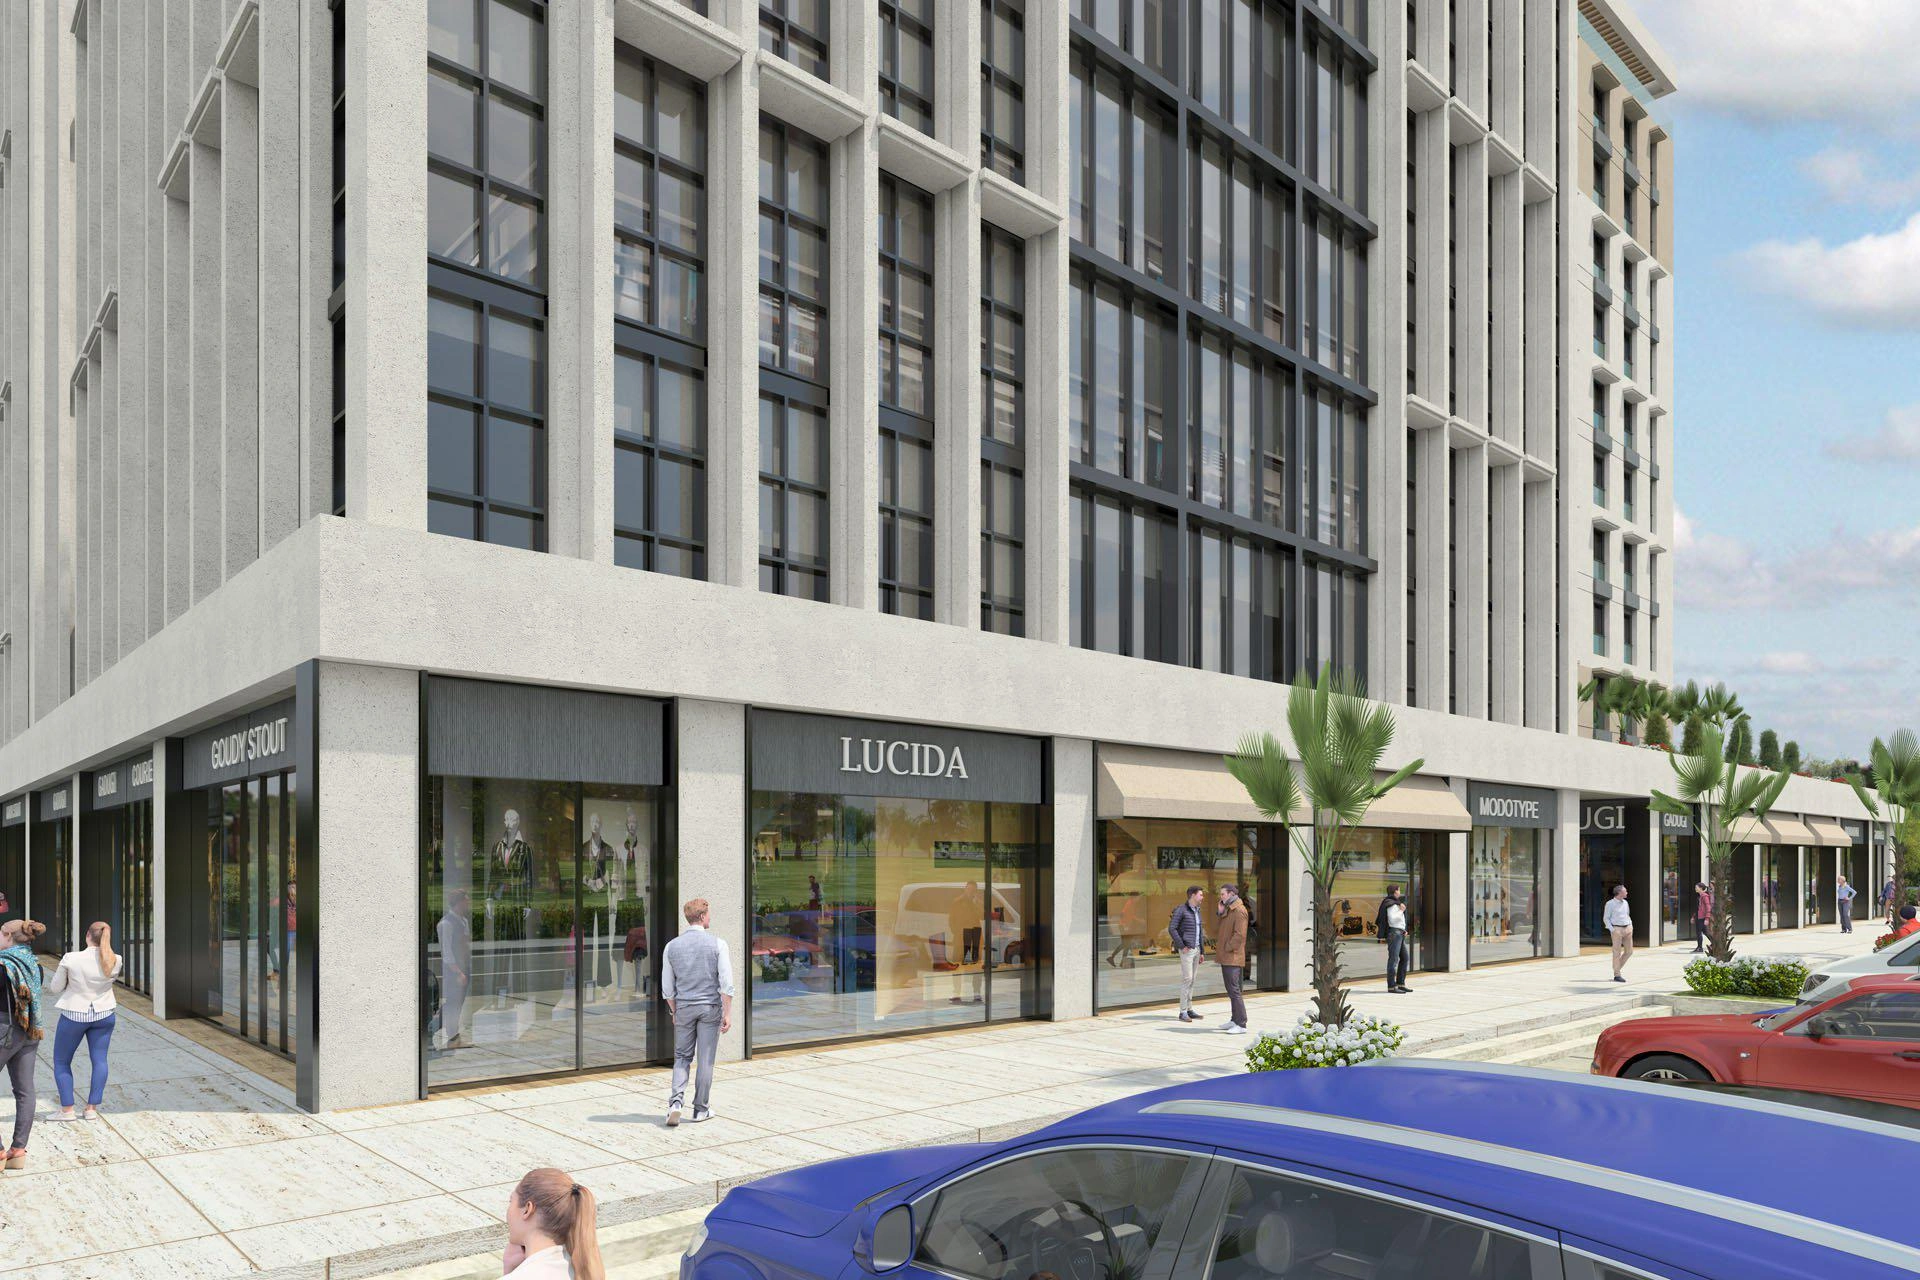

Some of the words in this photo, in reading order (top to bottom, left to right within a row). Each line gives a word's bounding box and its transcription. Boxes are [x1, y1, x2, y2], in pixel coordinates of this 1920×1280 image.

[211, 730, 248, 770] GOUDY
[247, 717, 288, 761] STOUT
[839, 736, 969, 779] LUCIDA
[1479, 796, 1540, 819] MODOTYPE
